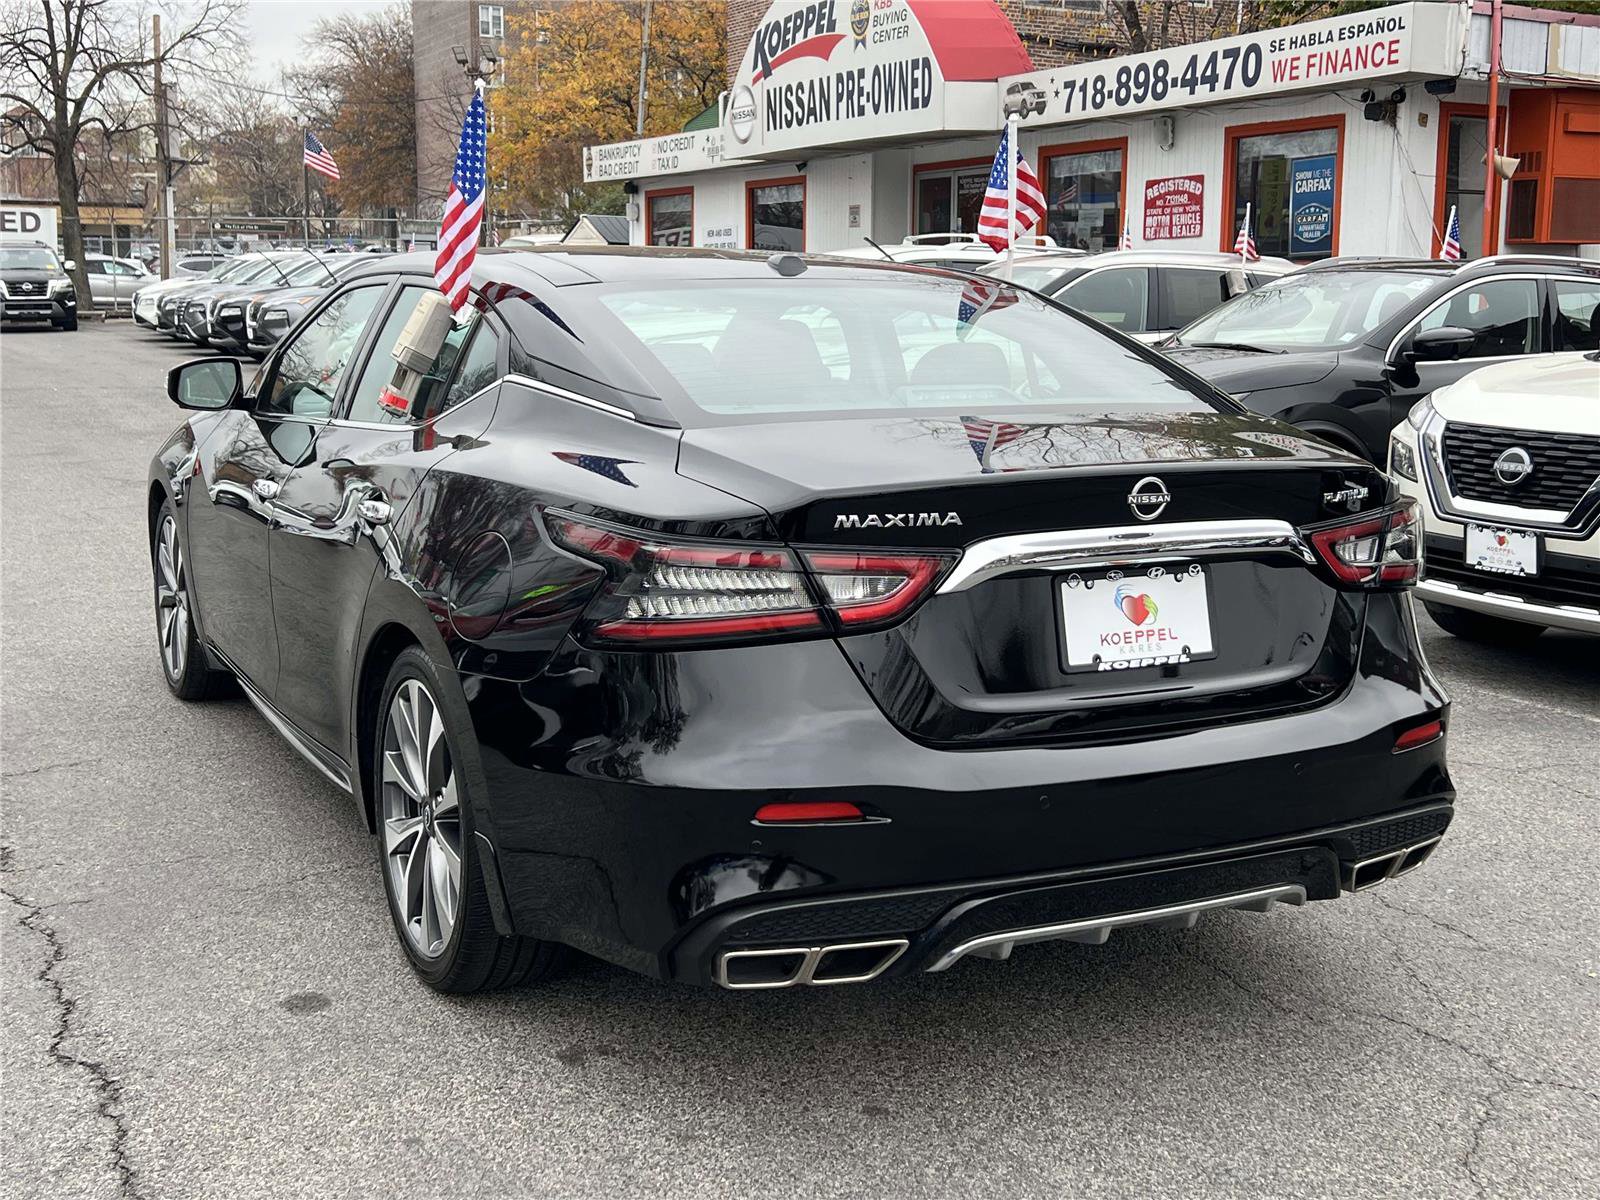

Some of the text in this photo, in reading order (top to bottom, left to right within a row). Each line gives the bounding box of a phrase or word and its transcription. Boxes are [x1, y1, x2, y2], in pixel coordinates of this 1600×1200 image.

[874, 0, 893, 10] KBB
[873, 8, 908, 28] BUYING
[752, 0, 837, 80] KOEPPEL
[873, 25, 910, 44] CENTER
[1269, 16, 1406, 54] SE HABLA ESPAÑOL
[1272, 39, 1401, 83] WE FINANCE
[1063, 42, 1263, 114] 718-898-4470
[766, 57, 933, 132] NISSAN PRE-OWNED
[732, 108, 755, 121] NISSAN
[599, 144, 642, 162] BANKRUPTCY
[657, 136, 695, 154] NO CREDIT
[599, 160, 639, 177] BAD CREDIT
[657, 155, 679, 170] TAX ID
[1295, 171, 1313, 181] SHOW
[1321, 168, 1332, 178] THE
[1146, 179, 1203, 200] REGISTERED
[1295, 177, 1332, 194] CARFAX
[1146, 205, 1201, 216] STATE OF NEW YORK
[0, 211, 41, 232] ED
[1145, 212, 1202, 228] MOTOR VEHICLE
[1145, 224, 1201, 239] RETAIL DEALER
[1494, 460, 1533, 473] NISSAN
[1128, 494, 1171, 504] NISSAN
[833, 511, 963, 529] MAXIMA
[1100, 628, 1179, 647] KOEPPEL
[1120, 642, 1162, 655] KARES
[1097, 653, 1191, 672] KOEPPEL
